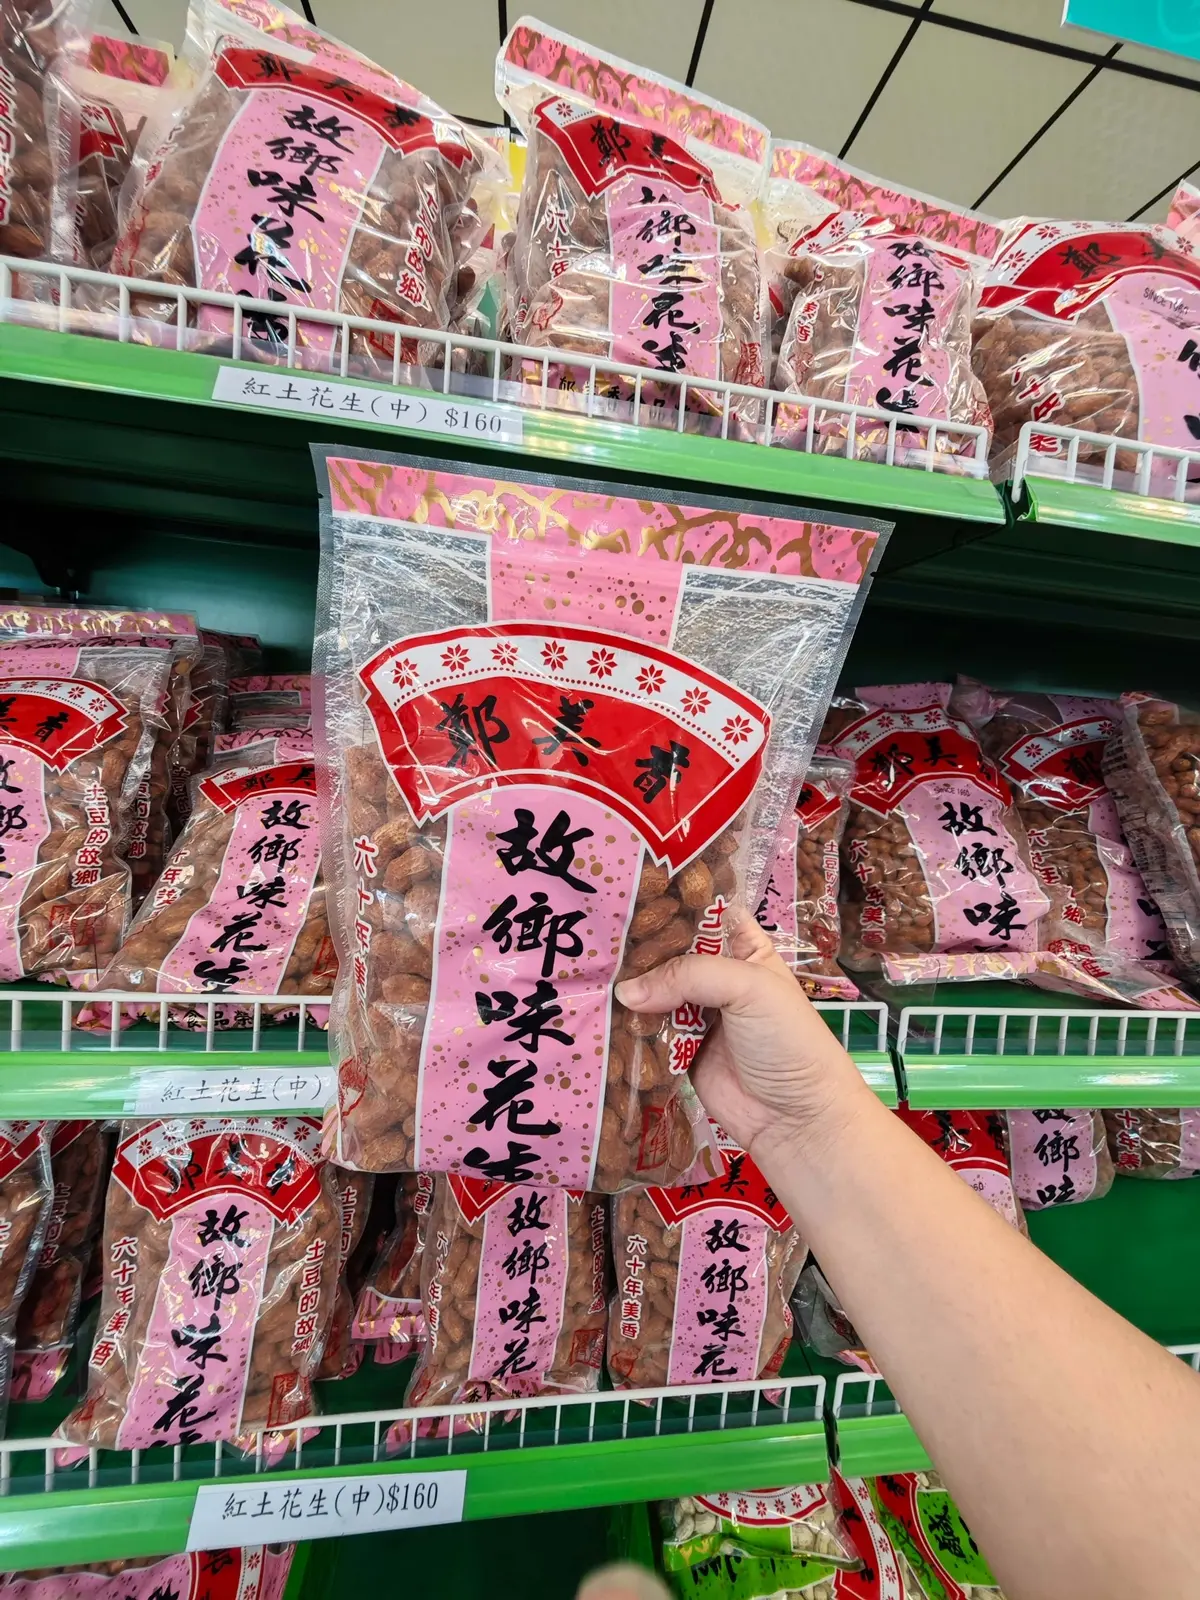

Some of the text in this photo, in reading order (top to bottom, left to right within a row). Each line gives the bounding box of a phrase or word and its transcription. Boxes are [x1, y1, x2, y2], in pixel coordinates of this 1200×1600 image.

[242, 376, 502, 434] 紅土花生(中) $160
[73, 784, 109, 887] 土豆的故鄉
[160, 1074, 323, 1103] 紅土花生(中)
[91, 1237, 138, 1367] 六十年美香
[150, 1204, 251, 1445] 故鄉味花
[292, 1238, 327, 1354] 土豆的故鄉
[620, 1235, 648, 1340] 六十年美香
